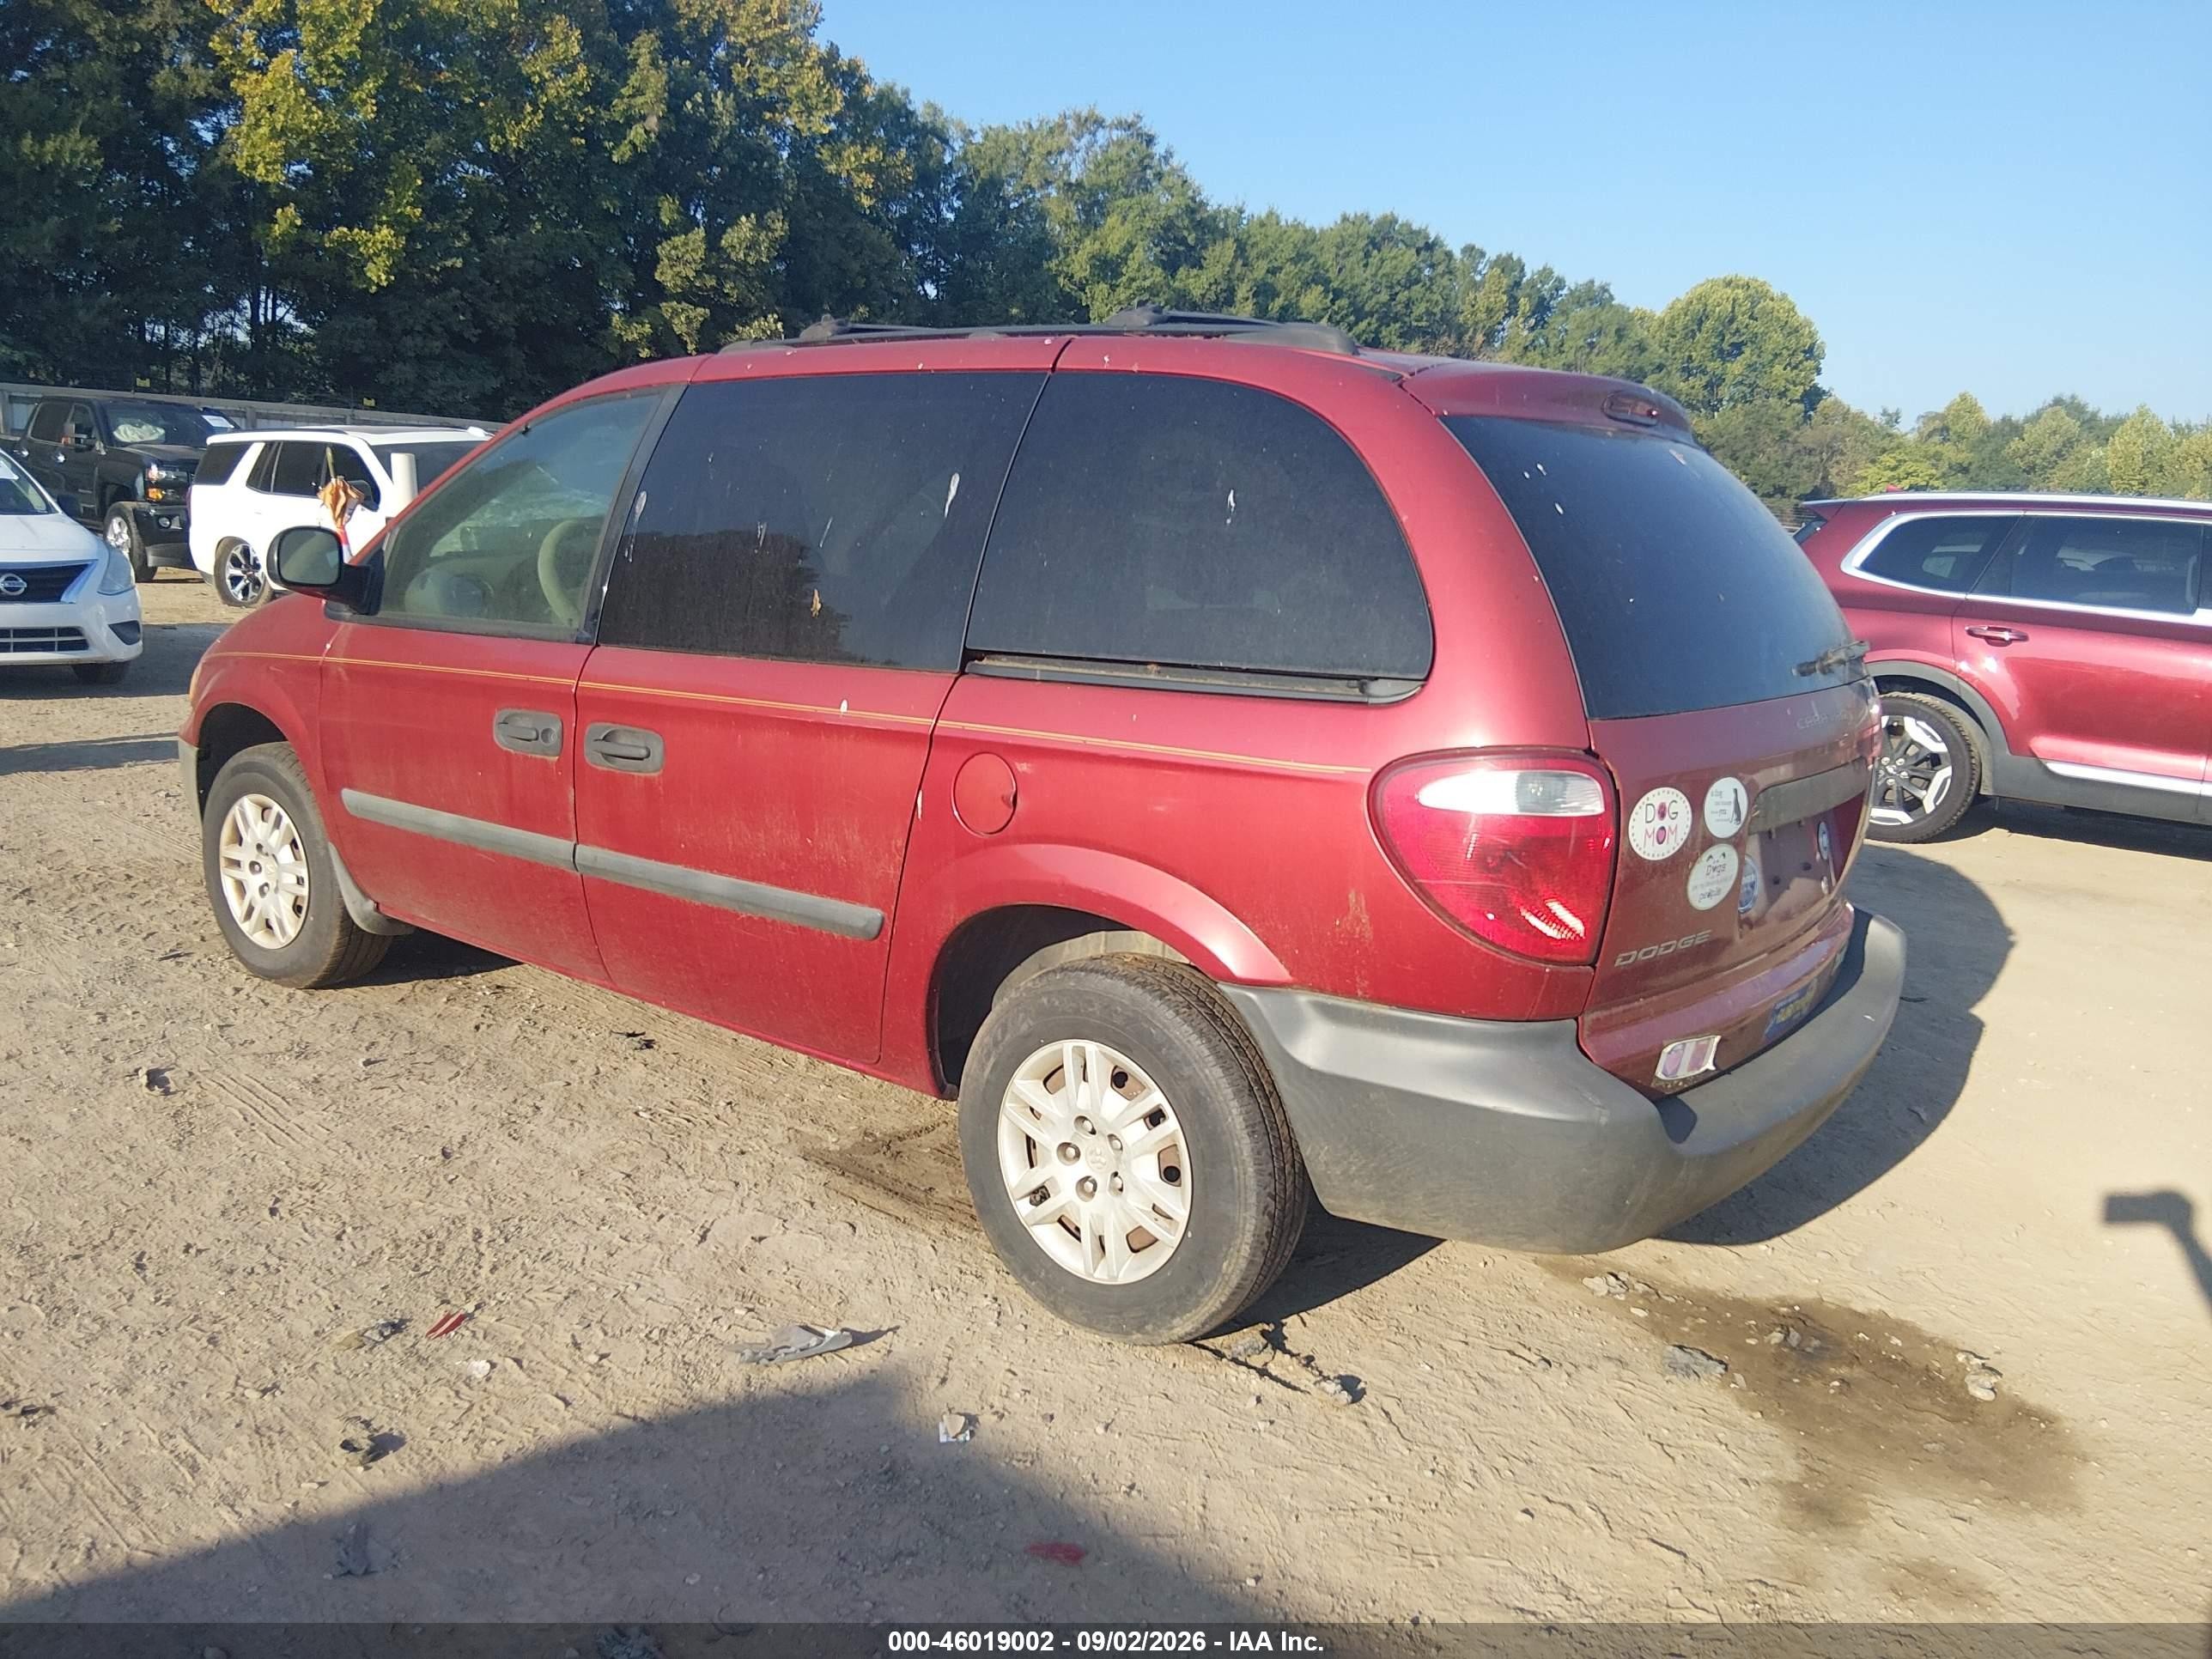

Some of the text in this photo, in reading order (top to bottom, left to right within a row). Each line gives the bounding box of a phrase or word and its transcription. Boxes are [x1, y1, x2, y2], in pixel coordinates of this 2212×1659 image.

[1796, 709, 1852, 728] CARA
[1644, 799, 1679, 823] DOG
[1644, 824, 1678, 848] MOM
[1614, 929, 1712, 968] DODGE
